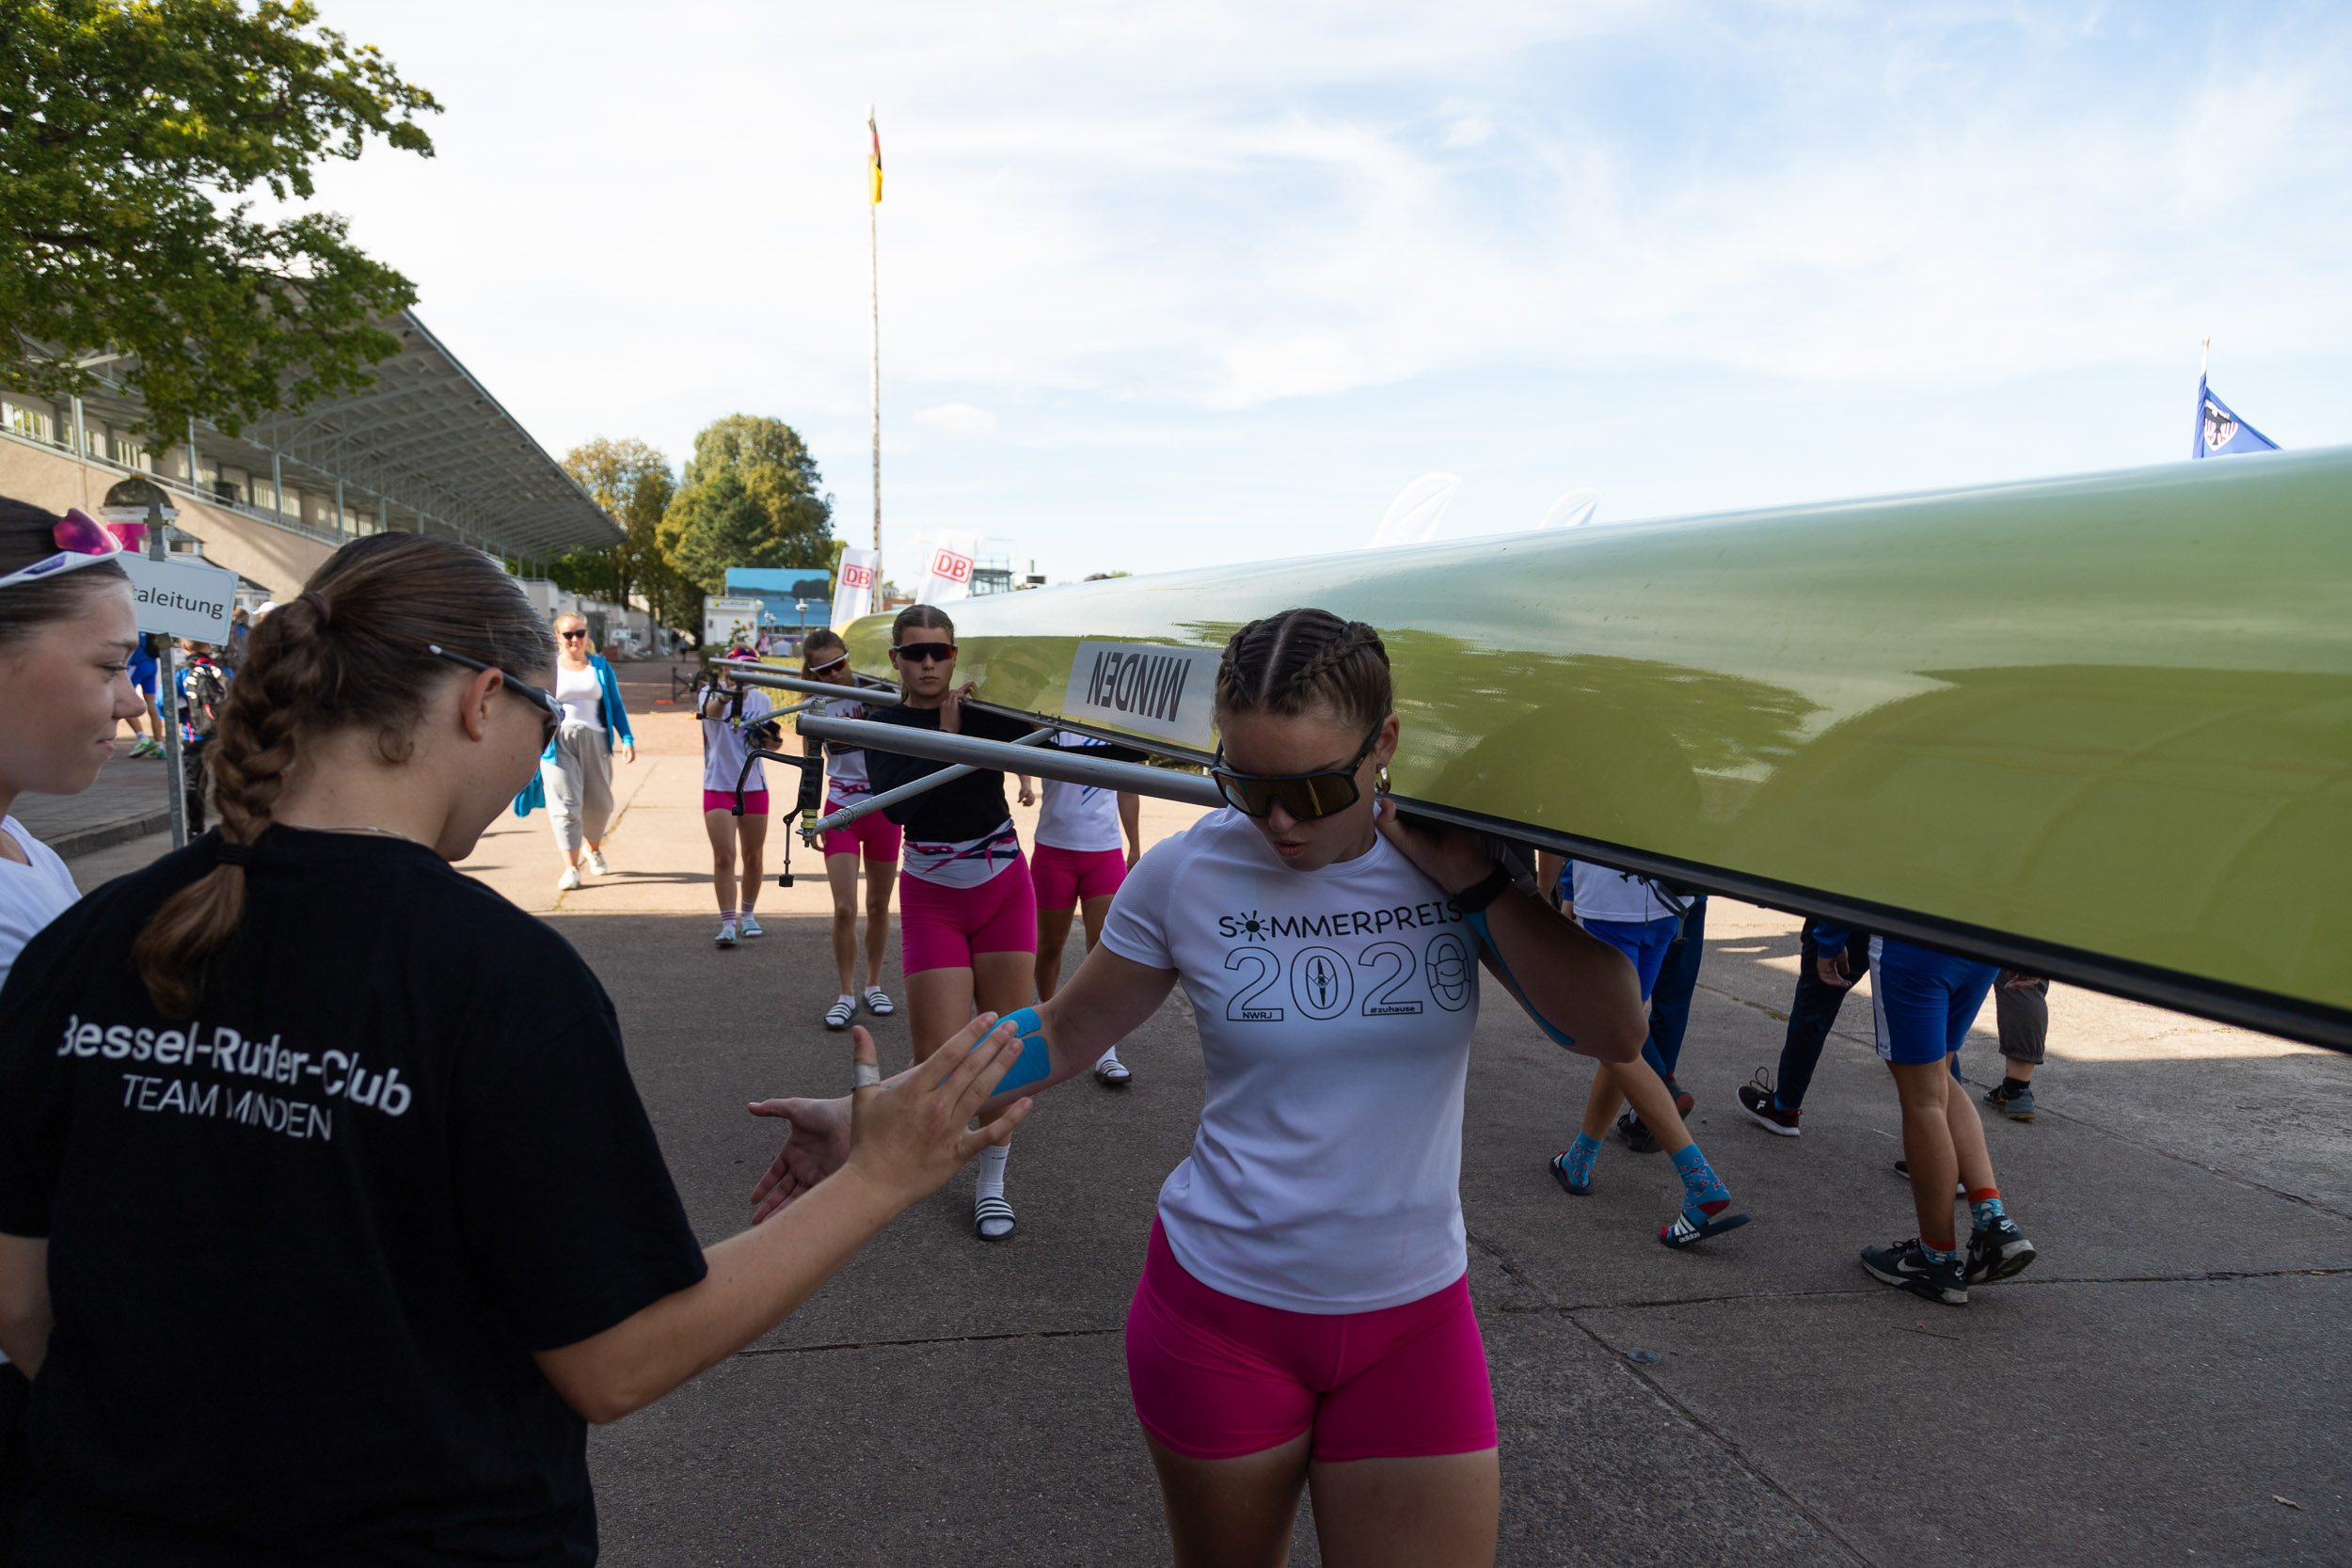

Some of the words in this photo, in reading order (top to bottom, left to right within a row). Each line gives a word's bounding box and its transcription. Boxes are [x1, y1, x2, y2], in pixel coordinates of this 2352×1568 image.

[937, 554, 966, 578] DB
[847, 568, 869, 585] DB
[1086, 651, 1192, 722] MINDEN
[1224, 933, 1471, 1022] 2020
[1242, 1011, 1273, 1020] NWRJ
[1370, 1006, 1416, 1014] #zuhause
[122, 1073, 220, 1117] TEAM
[1678, 1231, 1701, 1243] adidas
